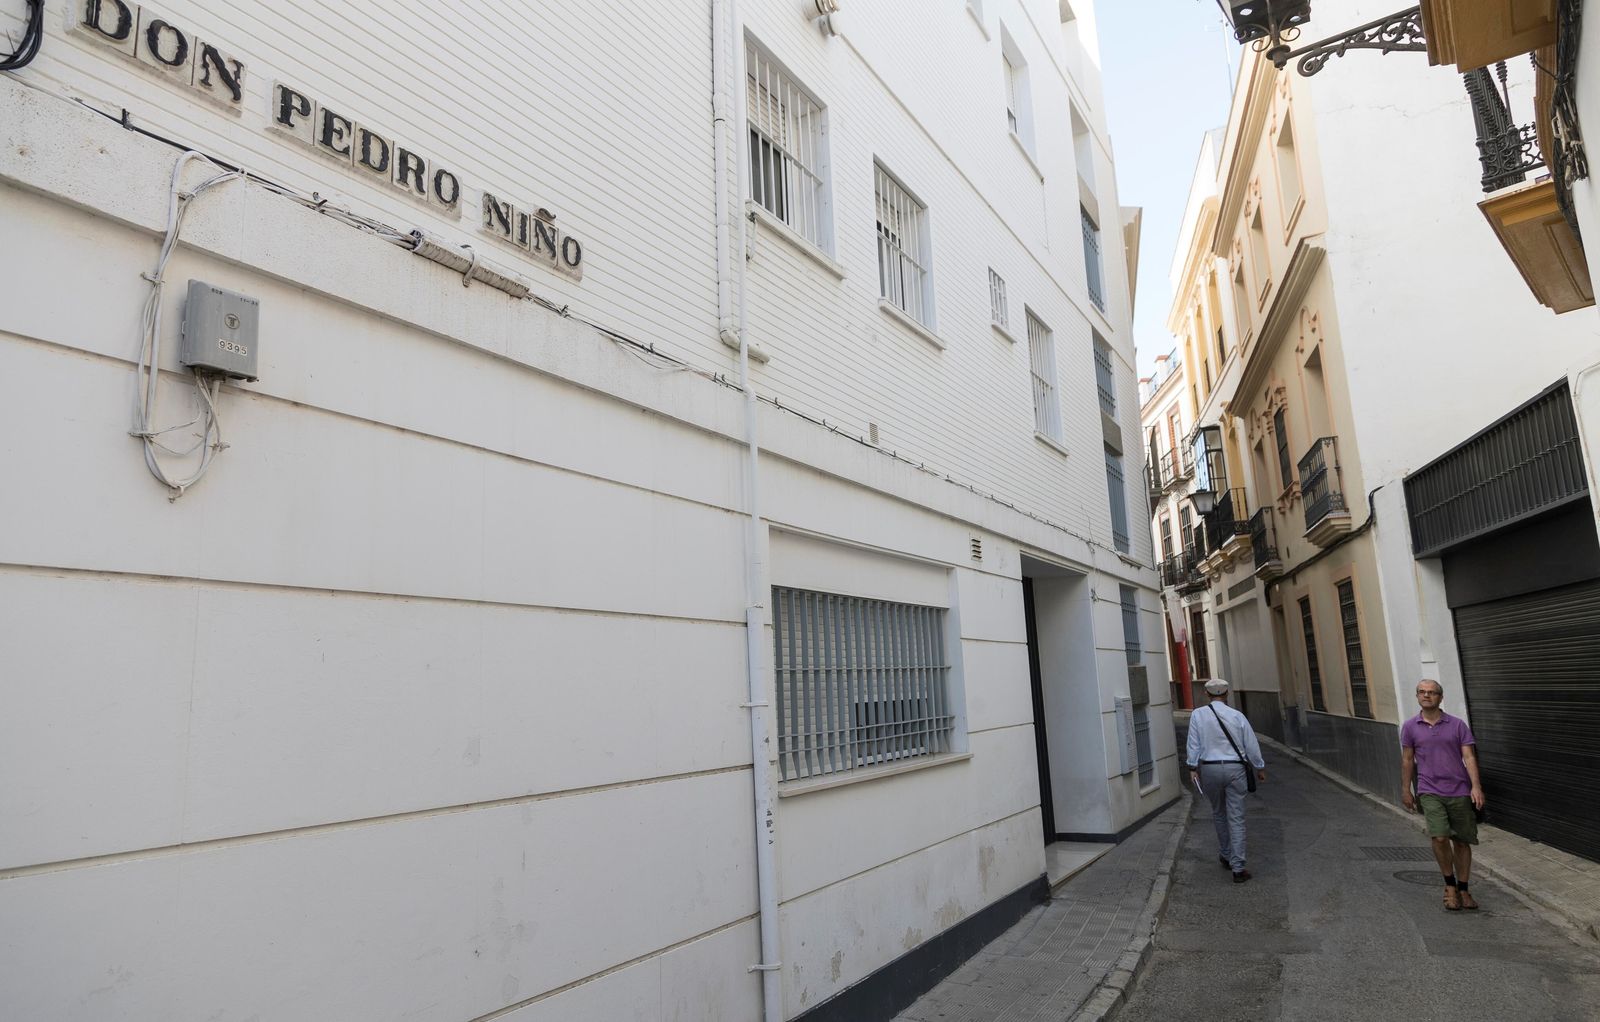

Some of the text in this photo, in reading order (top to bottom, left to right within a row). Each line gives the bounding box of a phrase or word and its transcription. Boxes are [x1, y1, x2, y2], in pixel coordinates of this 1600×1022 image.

[80, 0, 582, 267] DON PEDRO NIÑO
[219, 340, 247, 356] 9395
